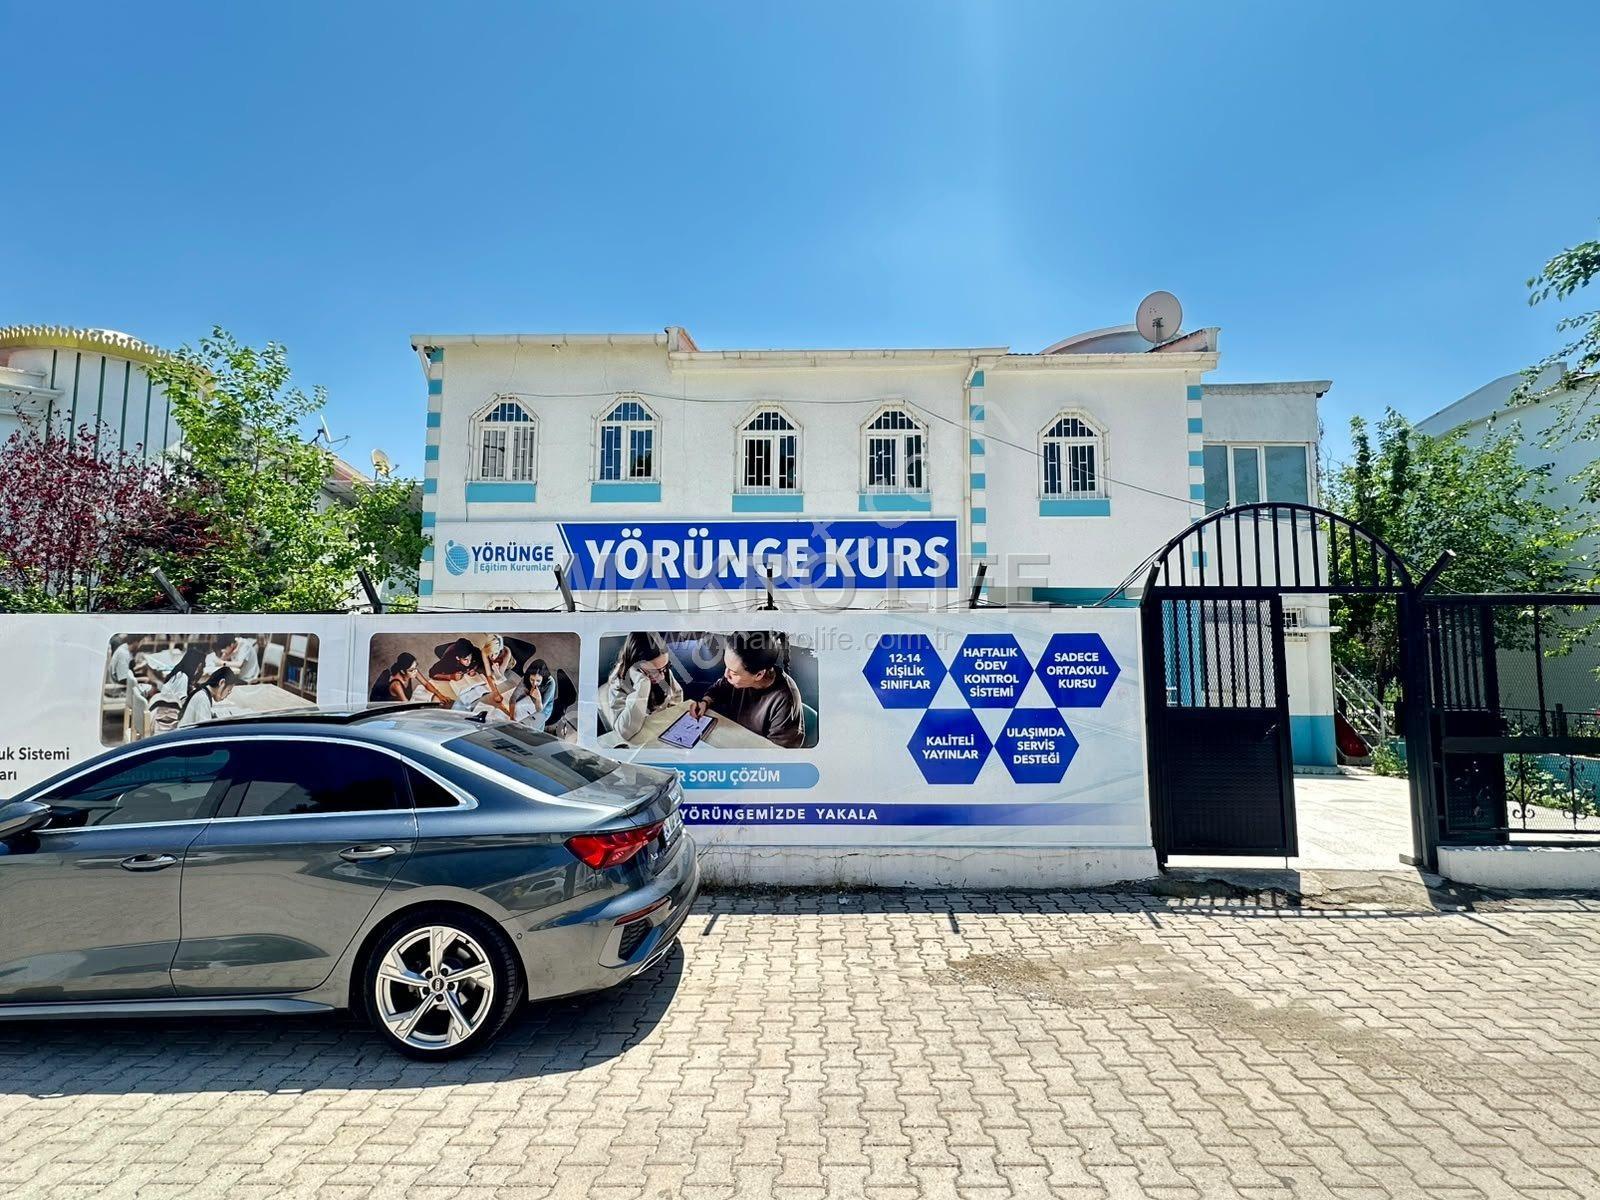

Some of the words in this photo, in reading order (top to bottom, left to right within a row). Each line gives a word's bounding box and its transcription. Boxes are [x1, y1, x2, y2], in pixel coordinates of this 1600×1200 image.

[472, 541, 554, 562] YÖRÜNGE
[585, 527, 809, 580] YÖRÜNGE
[824, 536, 950, 579] KURS
[480, 562, 508, 573] Eğitim
[510, 562, 554, 572] Kurumları
[888, 653, 921, 663] 12-14
[963, 648, 1018, 658] HAFTALIK
[1054, 652, 1099, 662] SADECE
[886, 664, 925, 678] KİŞİLİK
[974, 658, 1008, 671] ÖDEV
[1046, 665, 1109, 676] ORTAOKUL
[880, 679, 931, 690] SINIFLAR
[964, 674, 1019, 684] KONTROL
[1058, 679, 1097, 689] KURSU
[970, 685, 1014, 698] SİSTEMİ
[926, 733, 974, 746] KALİTELİ
[1007, 727, 1066, 739] ULAŞIMDA
[1017, 738, 1056, 751] SERVİS
[18, 747, 70, 760] Sistemi
[922, 749, 979, 760] YAYINLAR
[1013, 752, 1060, 765] DESTEĞİ
[689, 770, 726, 783] SORU
[729, 768, 780, 785] ÇÖZÜM
[679, 806, 806, 820] YÖRÜNGEMİZDE
[815, 808, 878, 820] YAKALA
